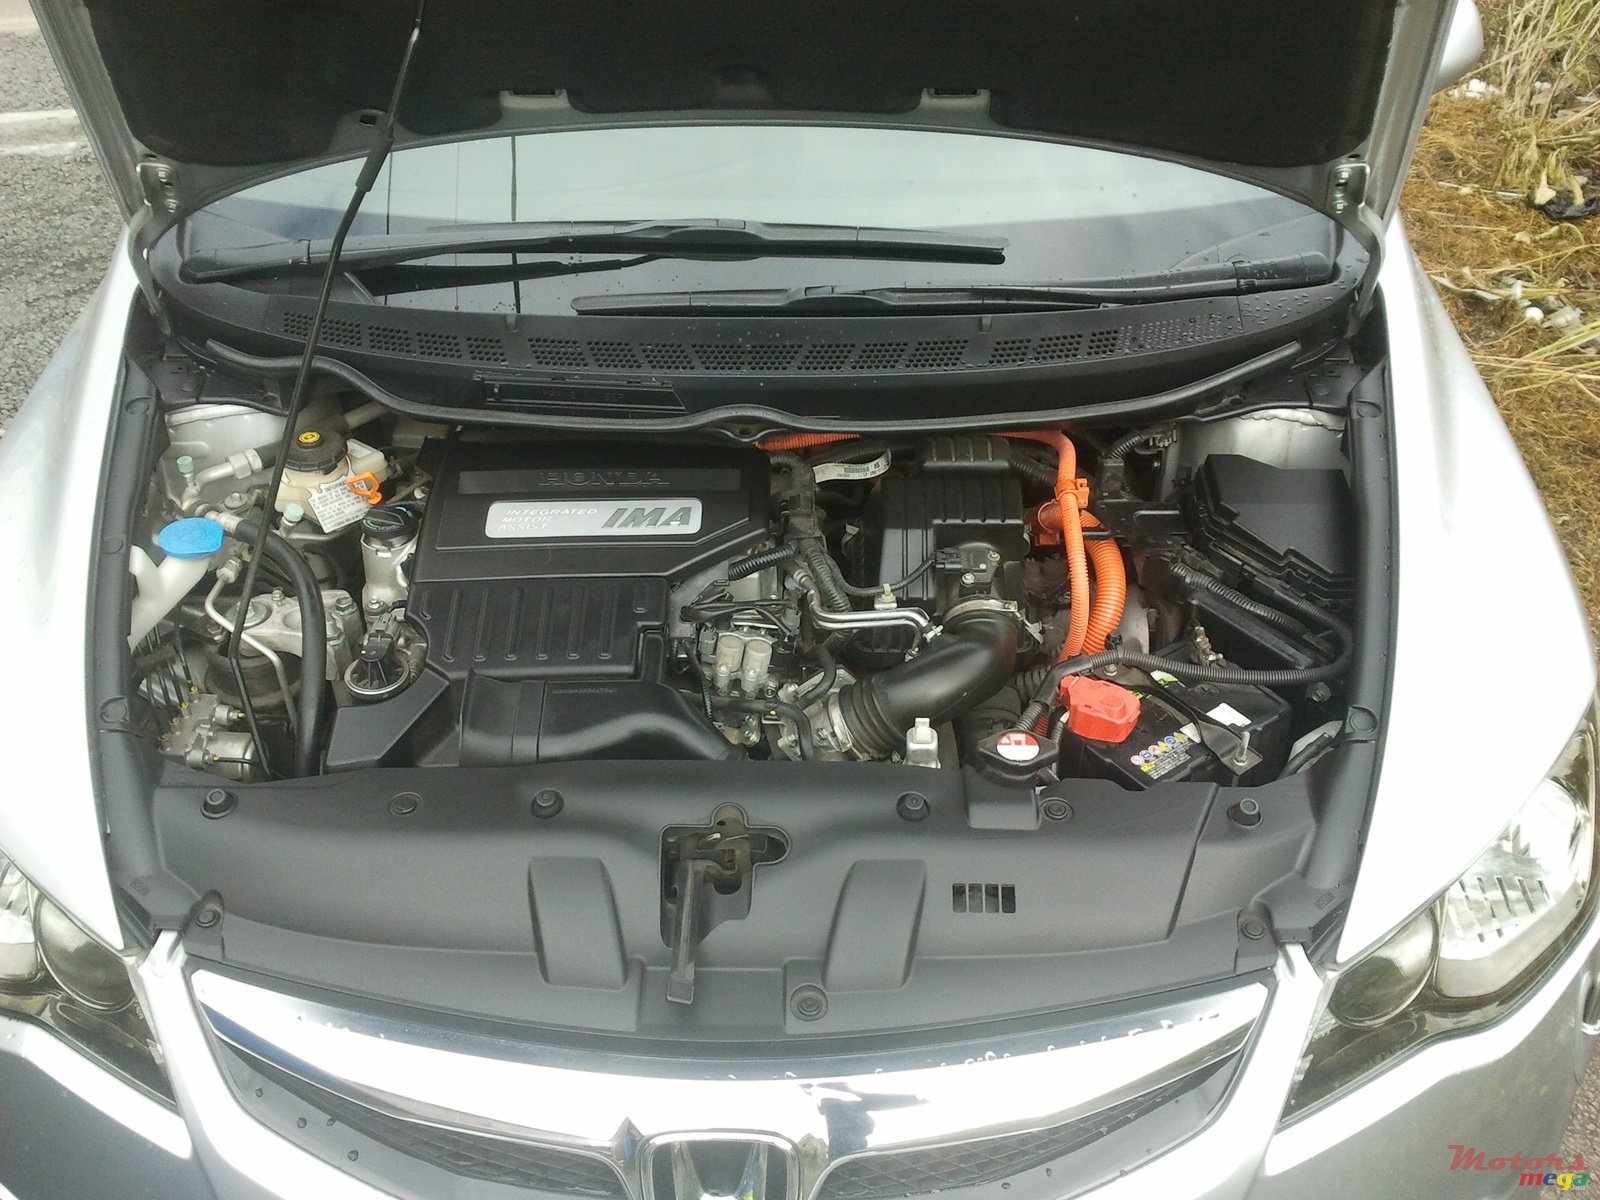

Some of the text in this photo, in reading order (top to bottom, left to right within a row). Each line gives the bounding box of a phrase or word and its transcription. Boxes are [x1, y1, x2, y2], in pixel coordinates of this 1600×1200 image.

[539, 472, 670, 486] HONDA
[506, 508, 598, 516] INTEGRATED
[502, 515, 552, 523] MOTOR
[601, 507, 692, 529] IMA
